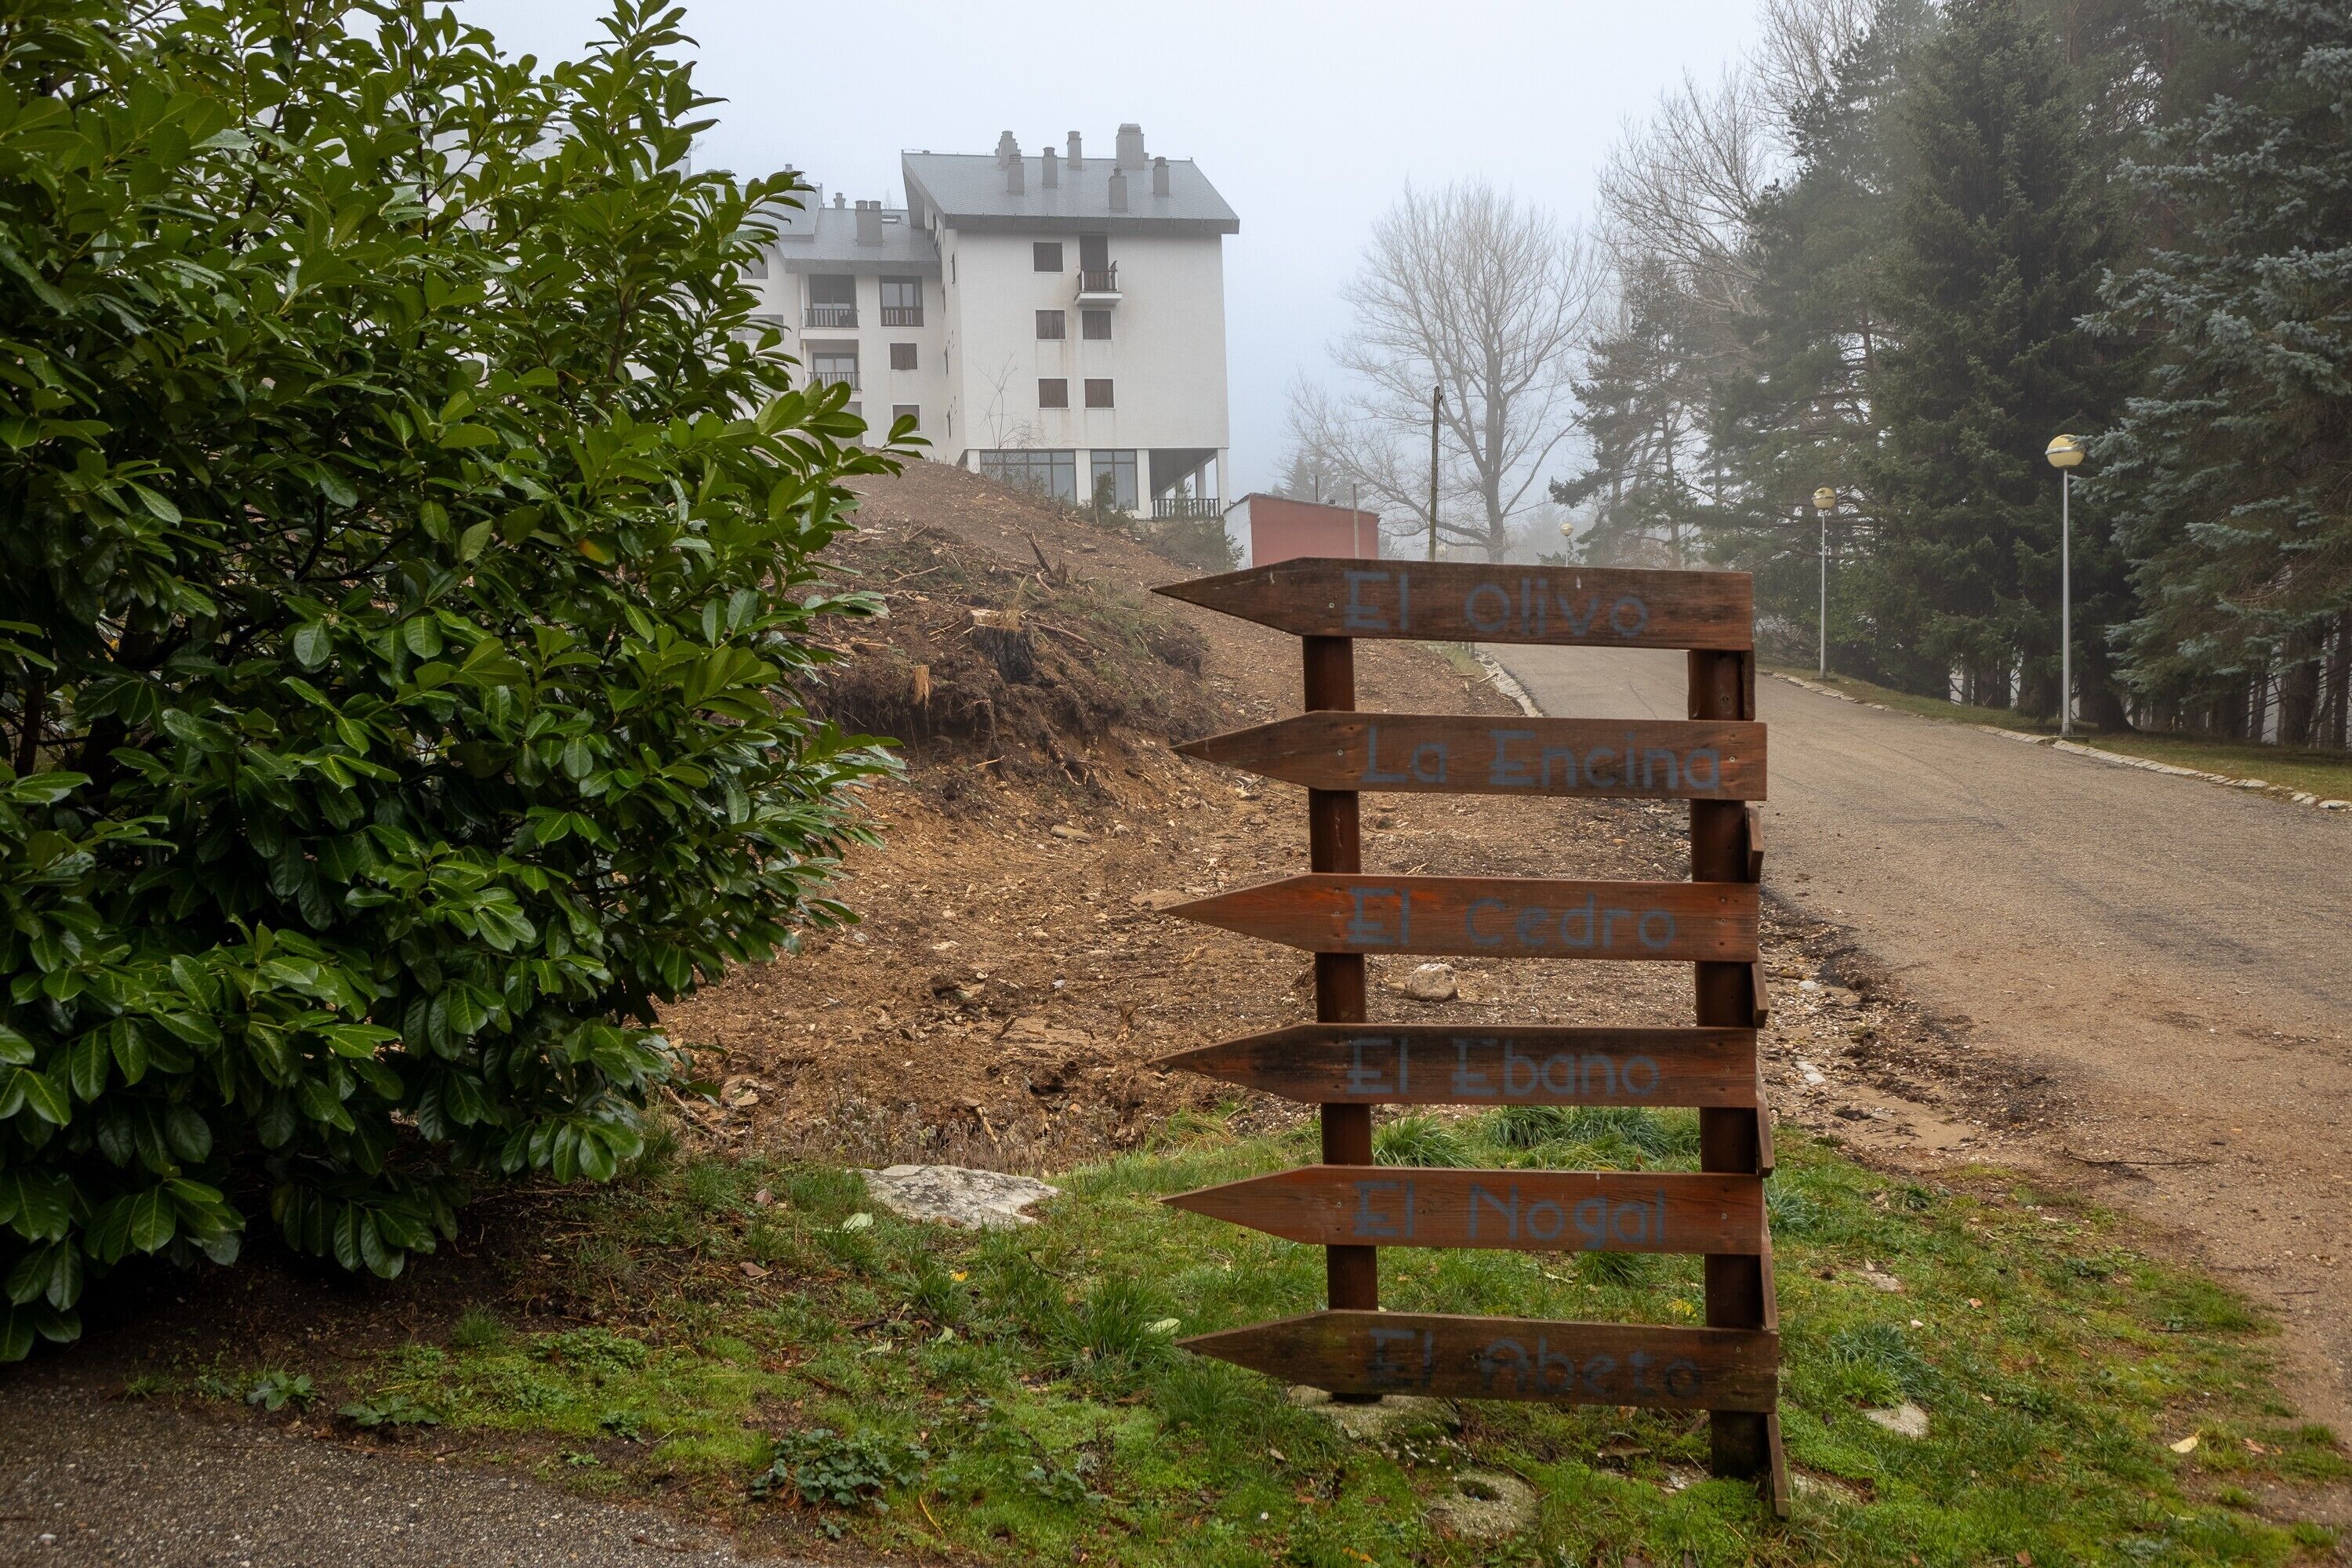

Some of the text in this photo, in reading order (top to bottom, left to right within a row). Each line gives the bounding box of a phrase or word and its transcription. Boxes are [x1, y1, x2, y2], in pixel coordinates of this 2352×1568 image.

[1344, 570, 1647, 637] El Olivo
[1361, 726, 1721, 790] La Encina
[1347, 887, 1676, 949] El Cedro
[1347, 1037, 1661, 1096] El Ebano
[1352, 1180, 1666, 1249] El Nogal
[1368, 1328, 1702, 1399] El Abeto
